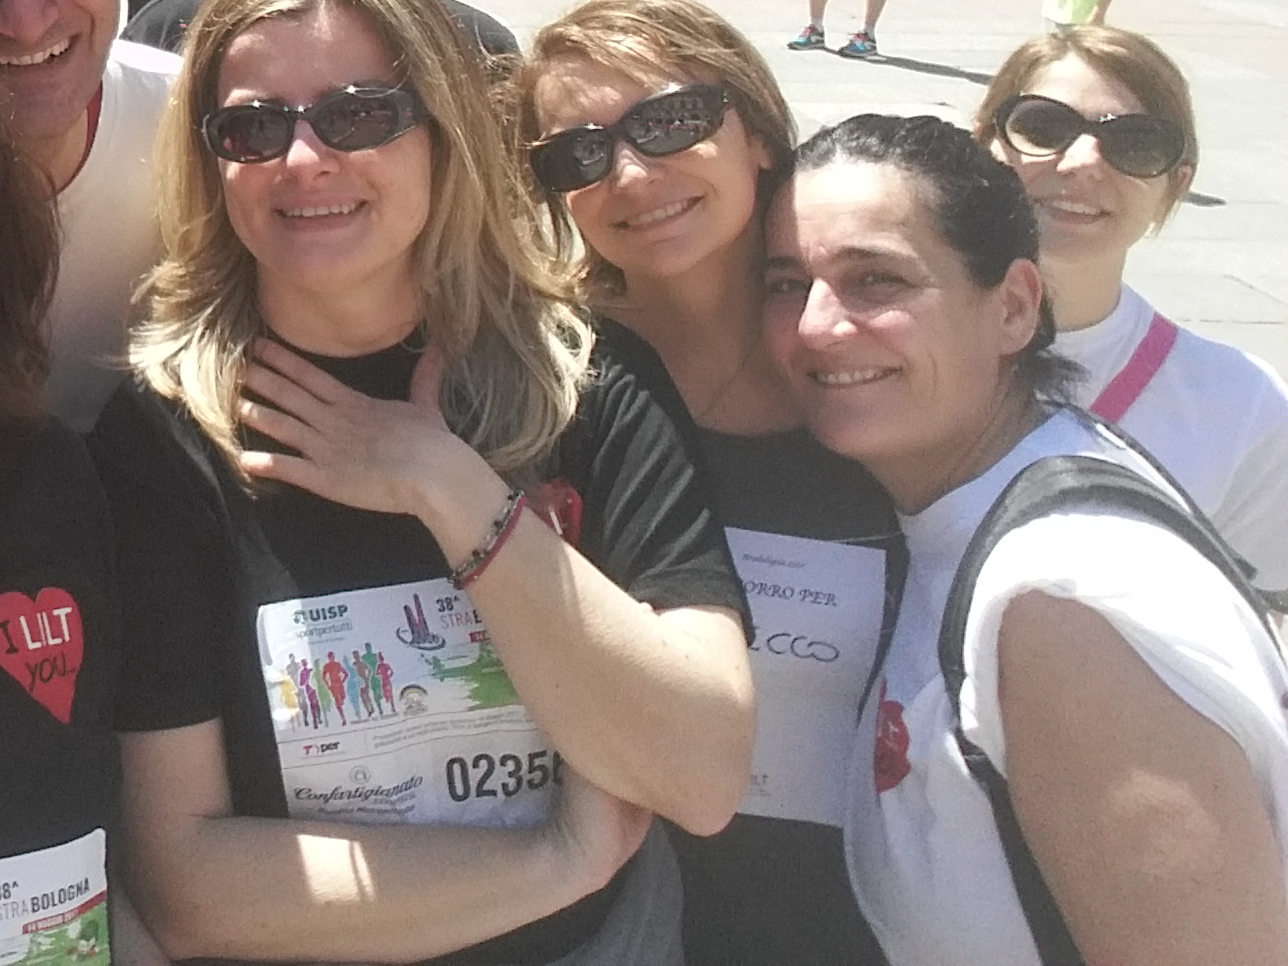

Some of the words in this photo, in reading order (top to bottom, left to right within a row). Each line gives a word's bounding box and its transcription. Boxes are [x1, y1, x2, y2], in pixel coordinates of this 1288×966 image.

[799, 588, 837, 607] PER
[309, 604, 348, 622] UISP
[19, 607, 72, 650] LILT
[294, 776, 423, 804] Confartigianato
